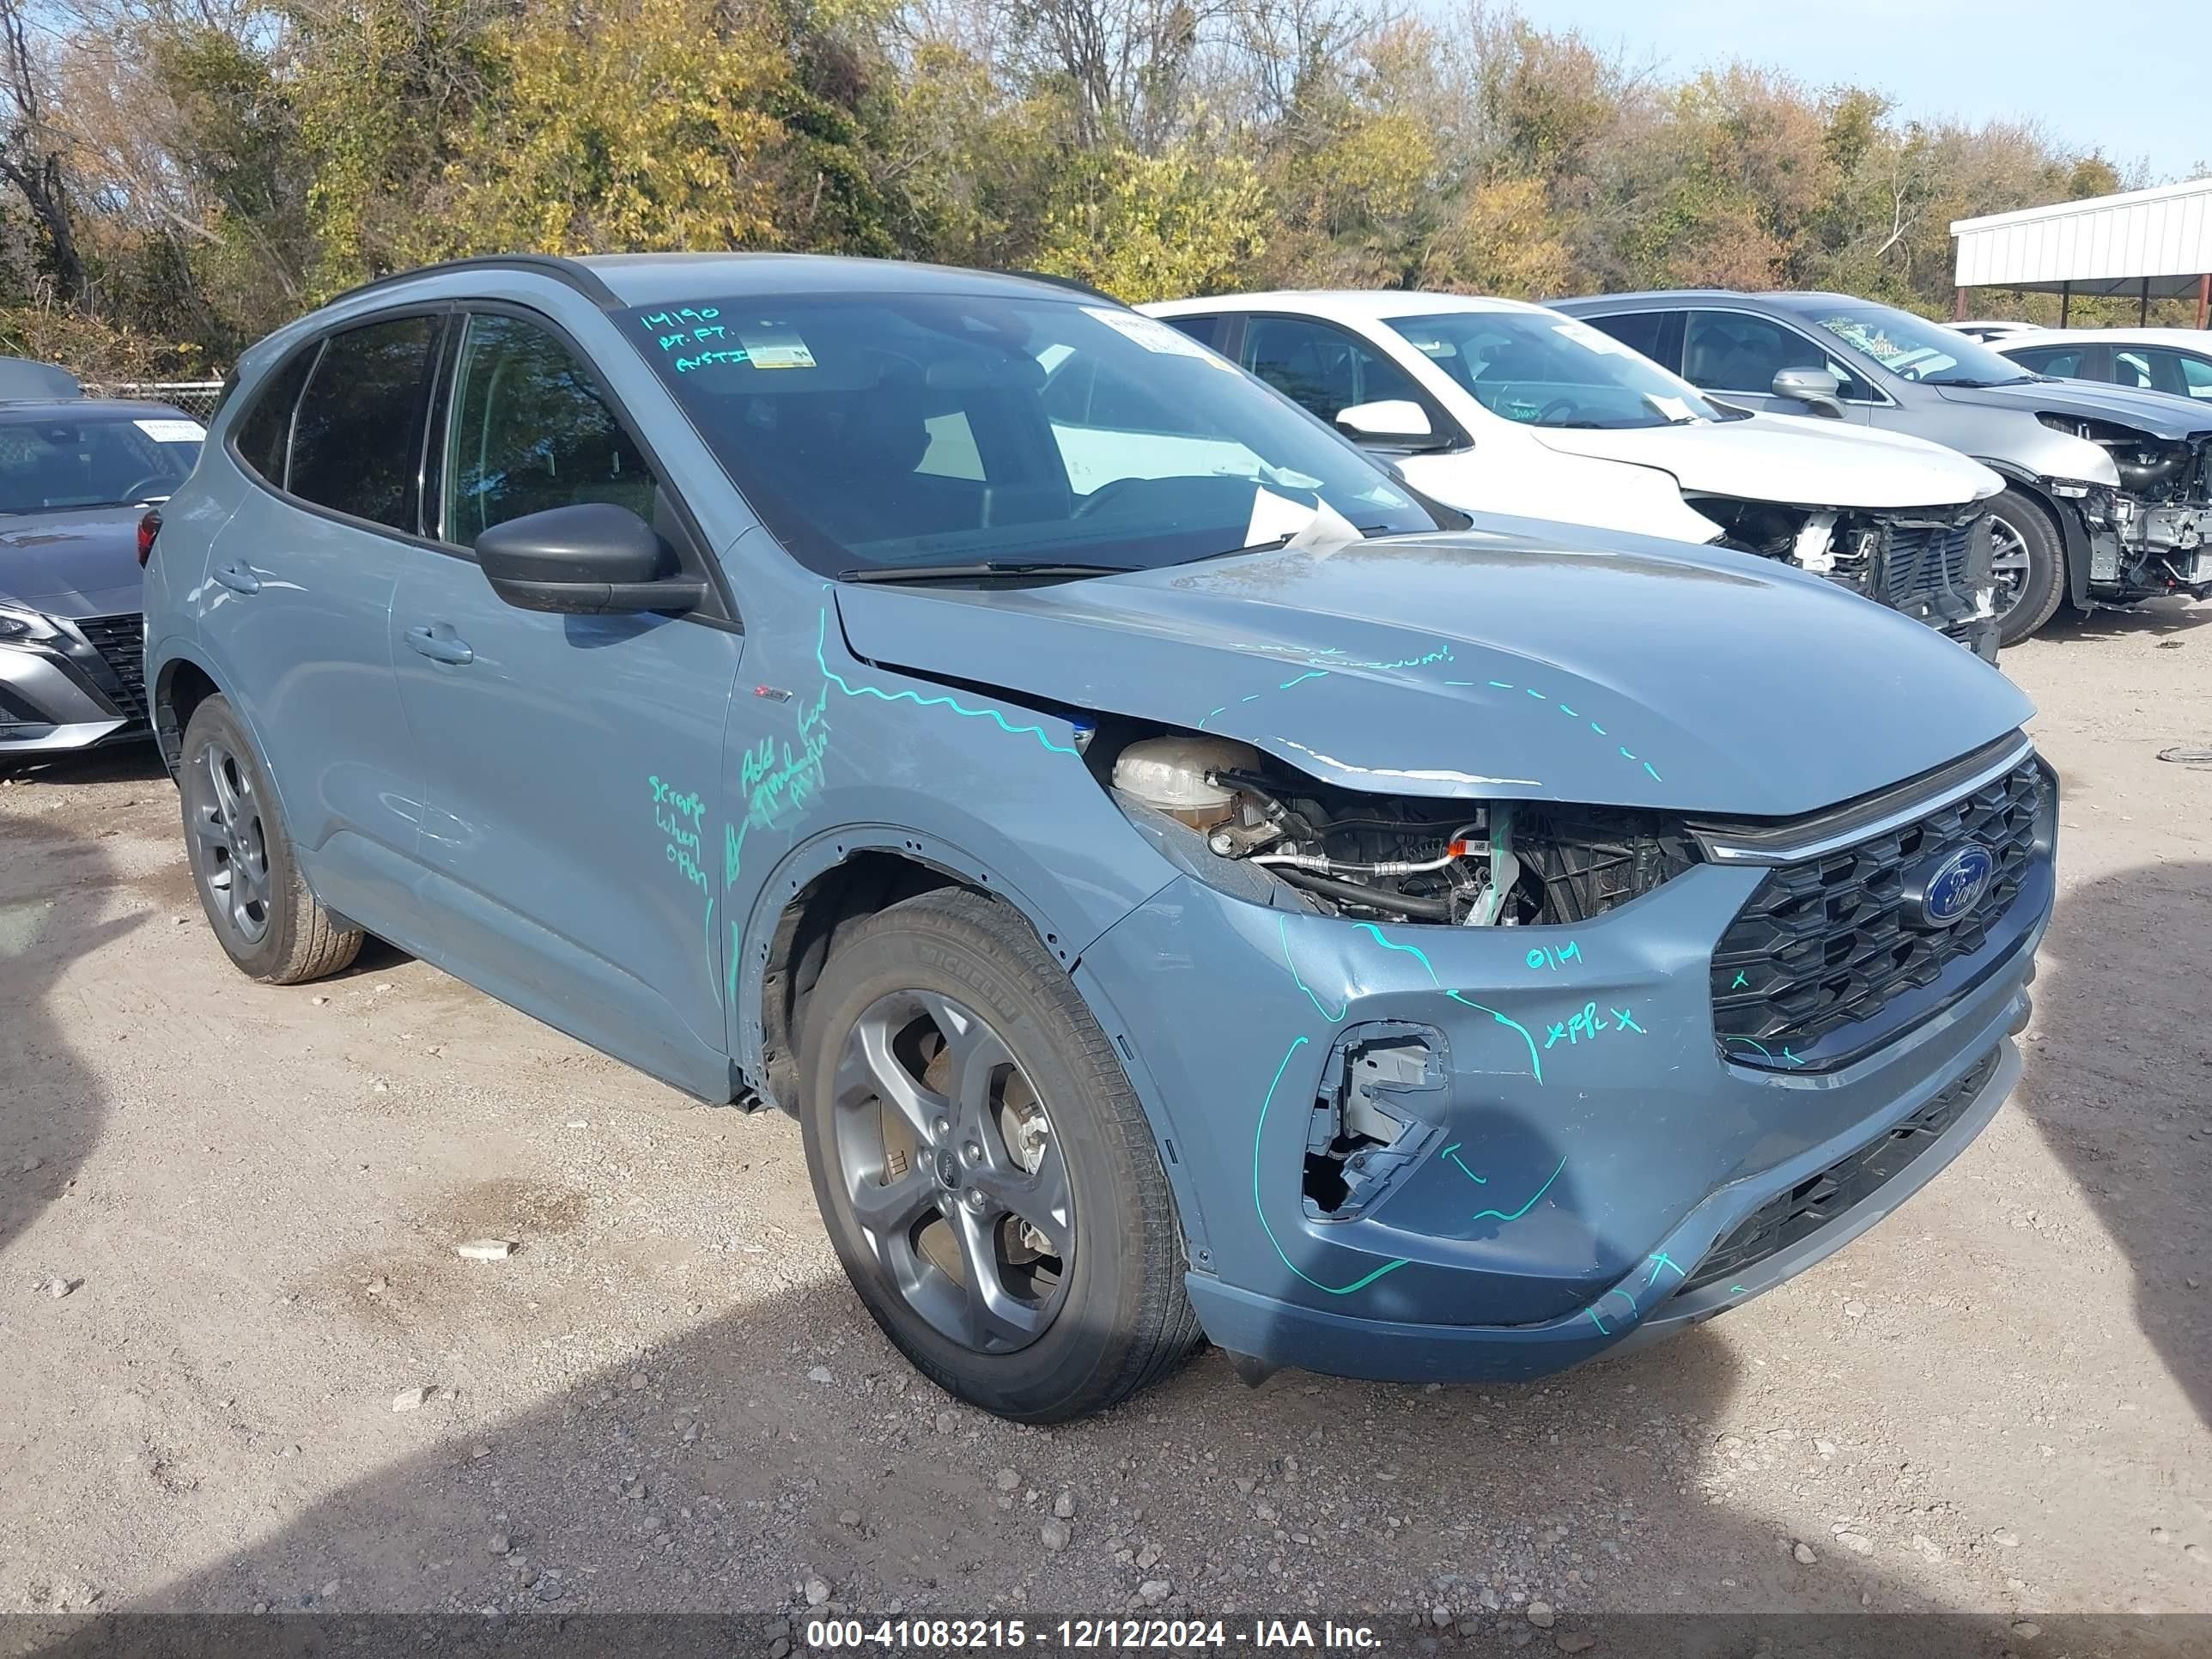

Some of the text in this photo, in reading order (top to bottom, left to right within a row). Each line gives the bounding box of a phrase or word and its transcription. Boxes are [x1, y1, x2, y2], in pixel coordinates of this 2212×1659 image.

[640, 307, 720, 331] 14190
[1944, 863, 1985, 912] Ford
[919, 945, 1017, 1018] MICHELIN
